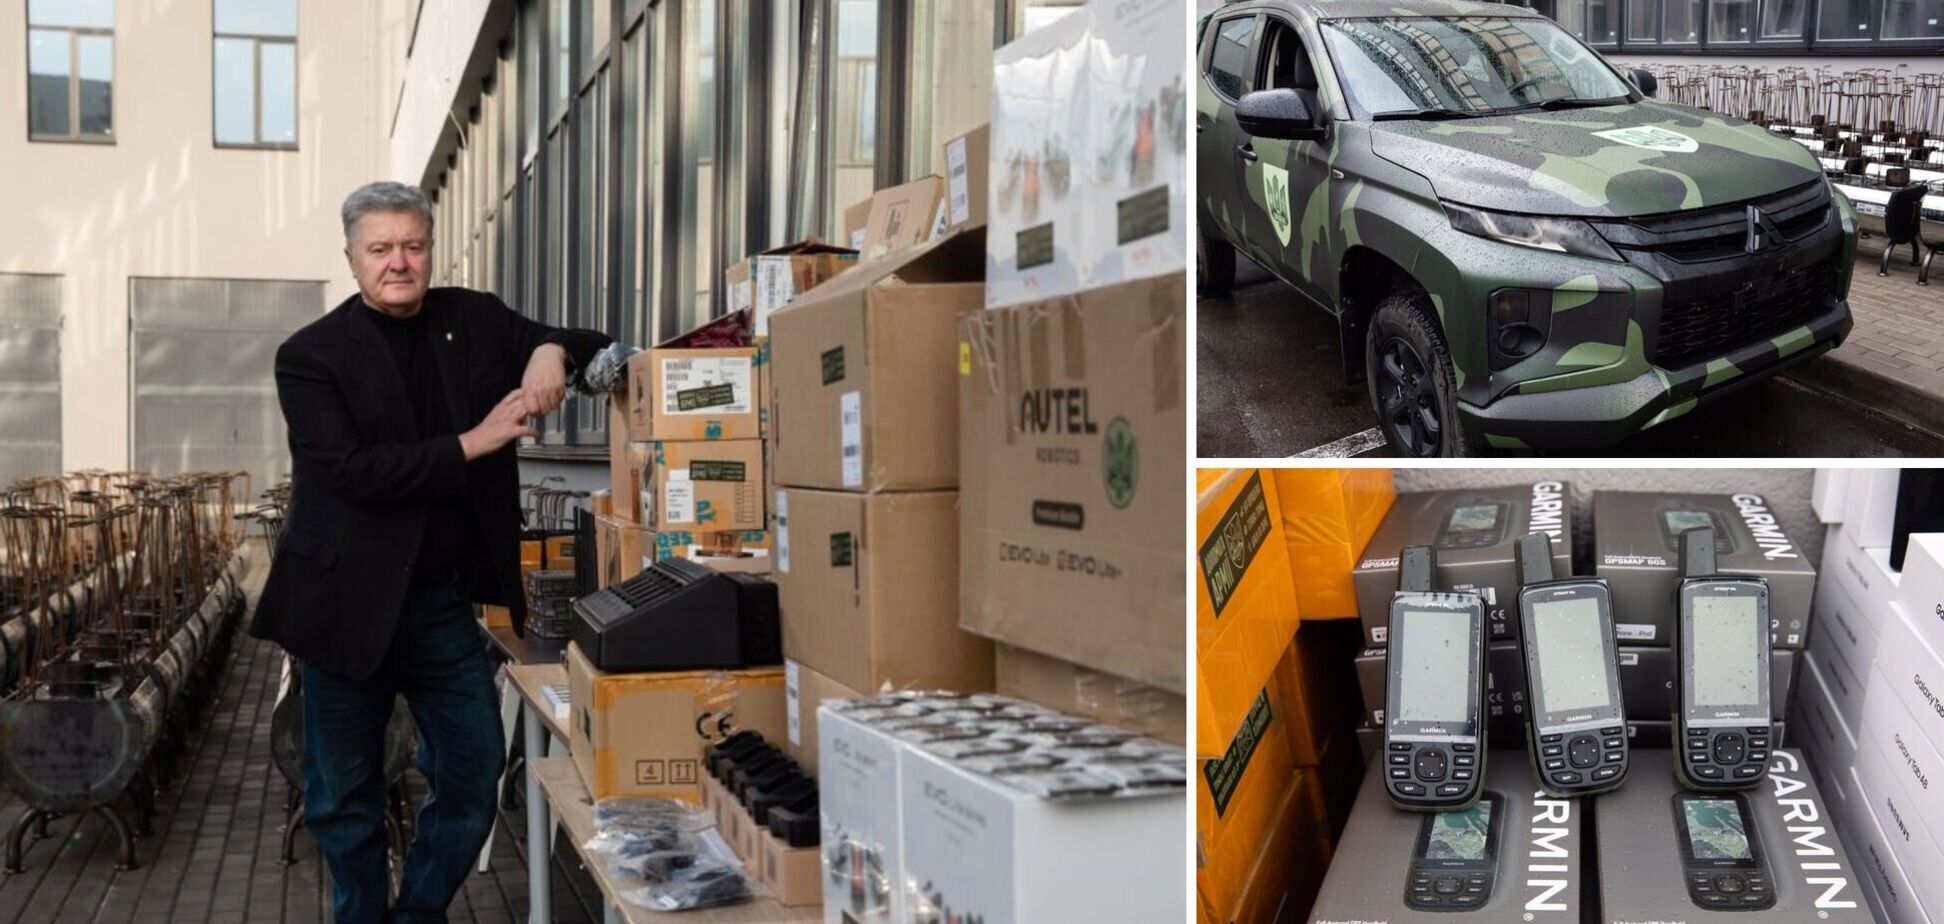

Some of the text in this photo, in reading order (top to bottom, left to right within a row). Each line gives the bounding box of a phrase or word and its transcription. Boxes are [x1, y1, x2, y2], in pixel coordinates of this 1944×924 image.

[1021, 387, 1098, 434] AUTEL
[1914, 674, 1936, 706] Galaxy
[1566, 714, 1593, 722] GARMIN
[1894, 733, 1913, 766] Galaxy
[1910, 759, 1922, 779] Tab
[1524, 790, 1571, 912] RMIN
